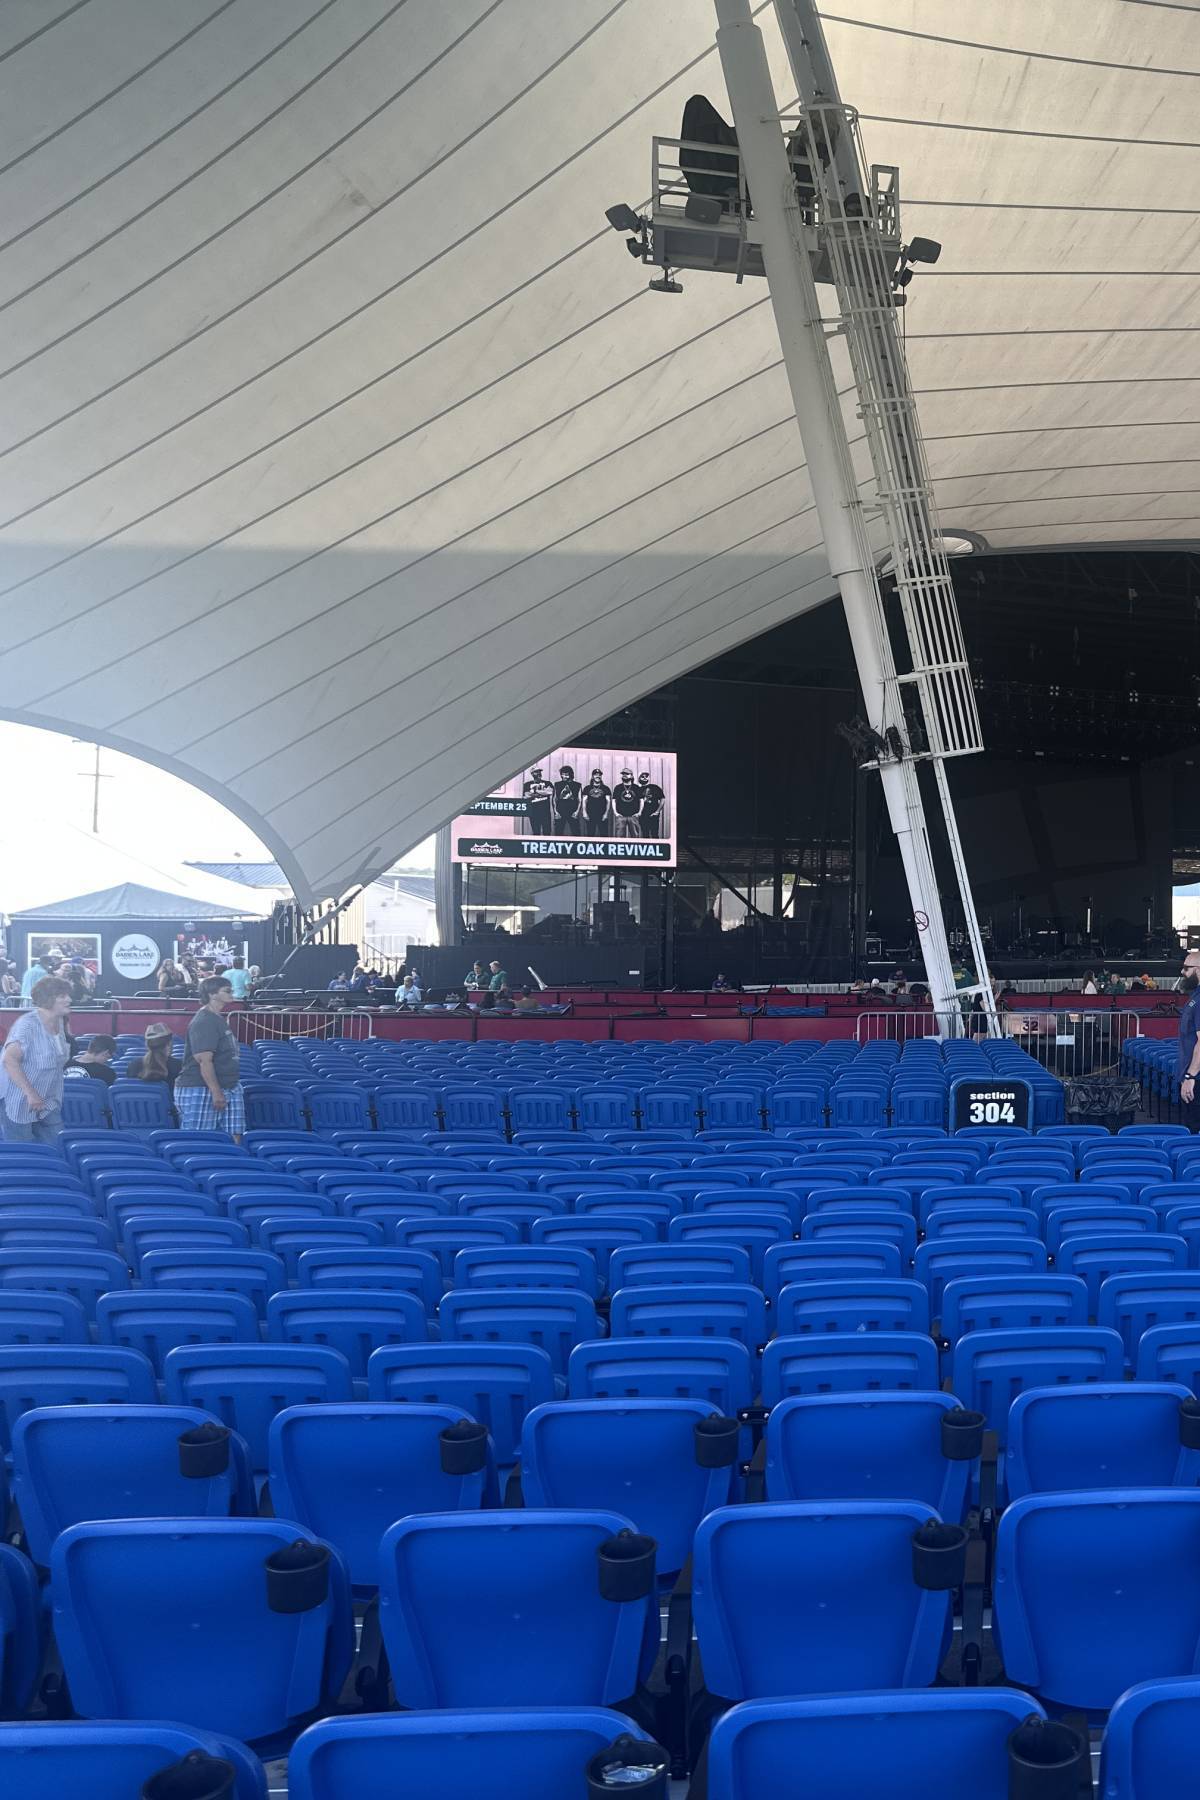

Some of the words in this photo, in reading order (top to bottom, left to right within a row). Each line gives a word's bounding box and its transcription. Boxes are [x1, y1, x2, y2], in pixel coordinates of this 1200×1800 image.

[469, 801, 514, 811] PTEMBER
[515, 803, 527, 811] 25
[521, 841, 574, 854] TREATY
[576, 843, 604, 855] OAK
[607, 844, 663, 857] REVIVAL
[1022, 1020, 1039, 1031] 32
[970, 1091, 1015, 1100] section
[969, 1102, 1016, 1123] 304
